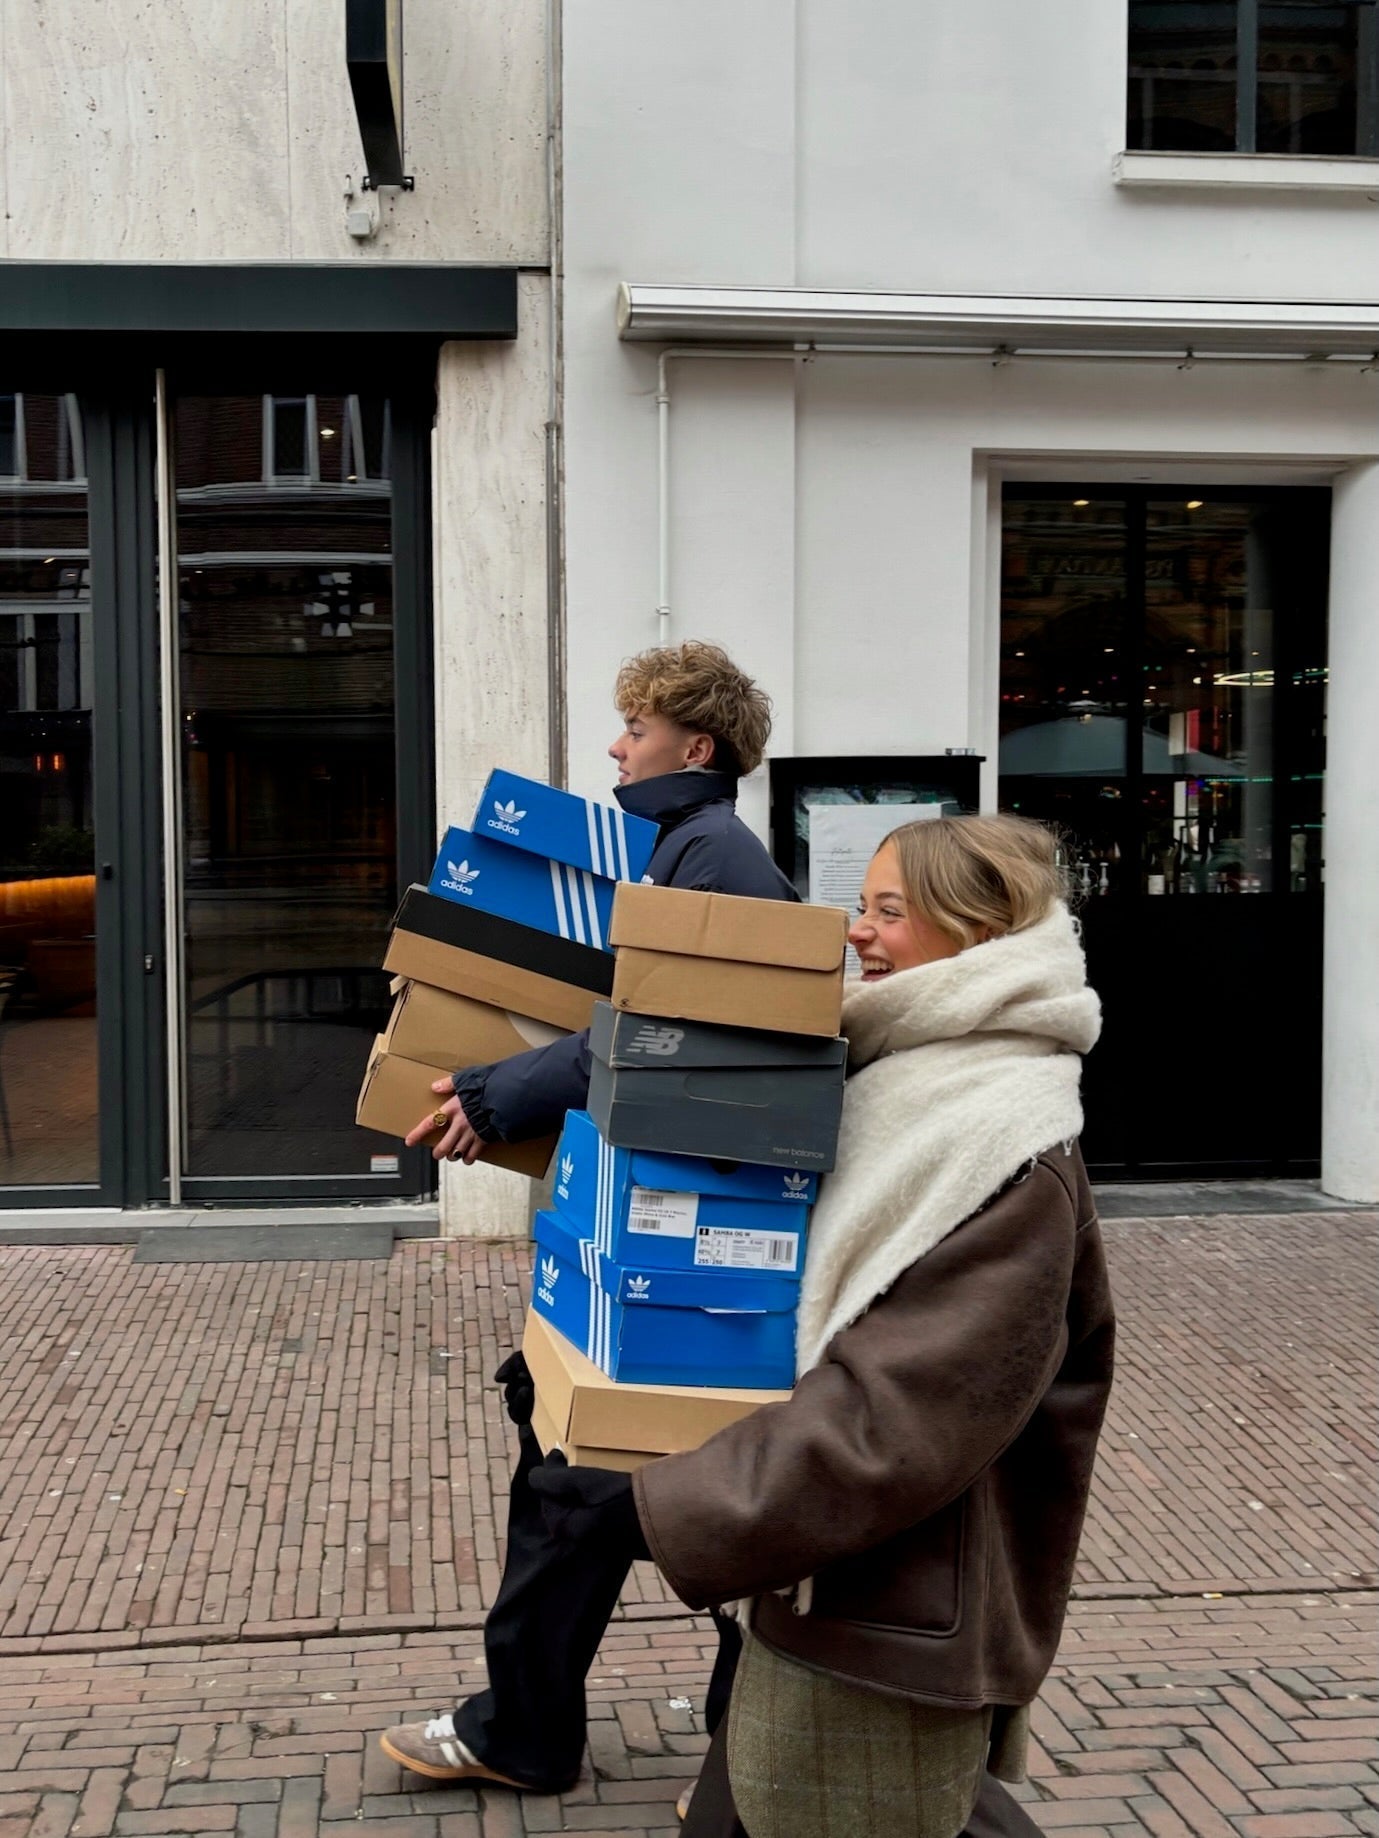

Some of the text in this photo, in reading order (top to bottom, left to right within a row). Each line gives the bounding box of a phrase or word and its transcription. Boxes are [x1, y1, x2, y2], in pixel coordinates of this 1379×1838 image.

[487, 819, 520, 836] adidas
[440, 879, 473, 896] adidas
[791, 1148, 825, 1160] balance
[781, 1190, 808, 1200] adidas
[537, 1286, 554, 1307] adidas
[626, 1291, 649, 1299] adidas
